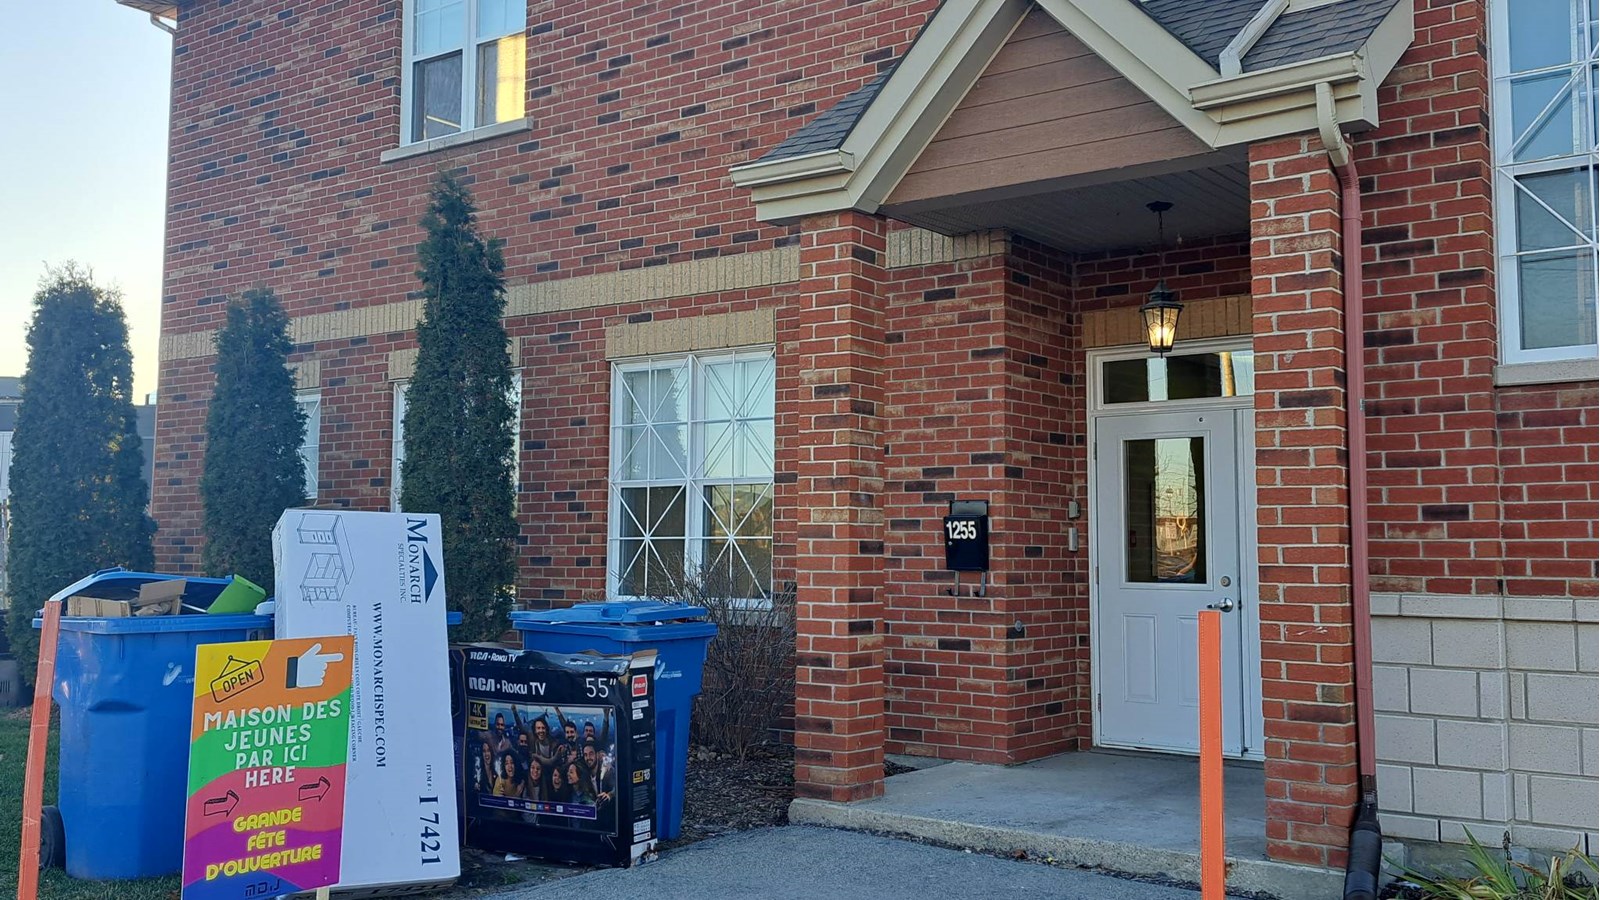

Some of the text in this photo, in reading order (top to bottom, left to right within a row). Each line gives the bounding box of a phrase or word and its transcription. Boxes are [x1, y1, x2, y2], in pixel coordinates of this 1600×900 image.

[946, 520, 977, 540] 1255
[398, 543, 406, 587] SPECIALTIES
[508, 654, 518, 663] TV
[222, 669, 254, 693] OPEN
[372, 602, 386, 768] WWW.MONARCHSPEC.COM
[468, 676, 496, 692] RCA
[529, 681, 546, 696] TV
[203, 699, 342, 732] MAISON DES
[472, 703, 483, 717] 4K
[224, 724, 312, 751] JEUNES
[235, 744, 307, 770] PAR ICI
[245, 766, 296, 788] HERE
[233, 806, 303, 832] GRANDE
[247, 830, 286, 851] FÊTE
[420, 812, 441, 866] 7421
[205, 844, 322, 881] D'OUVERTURE
